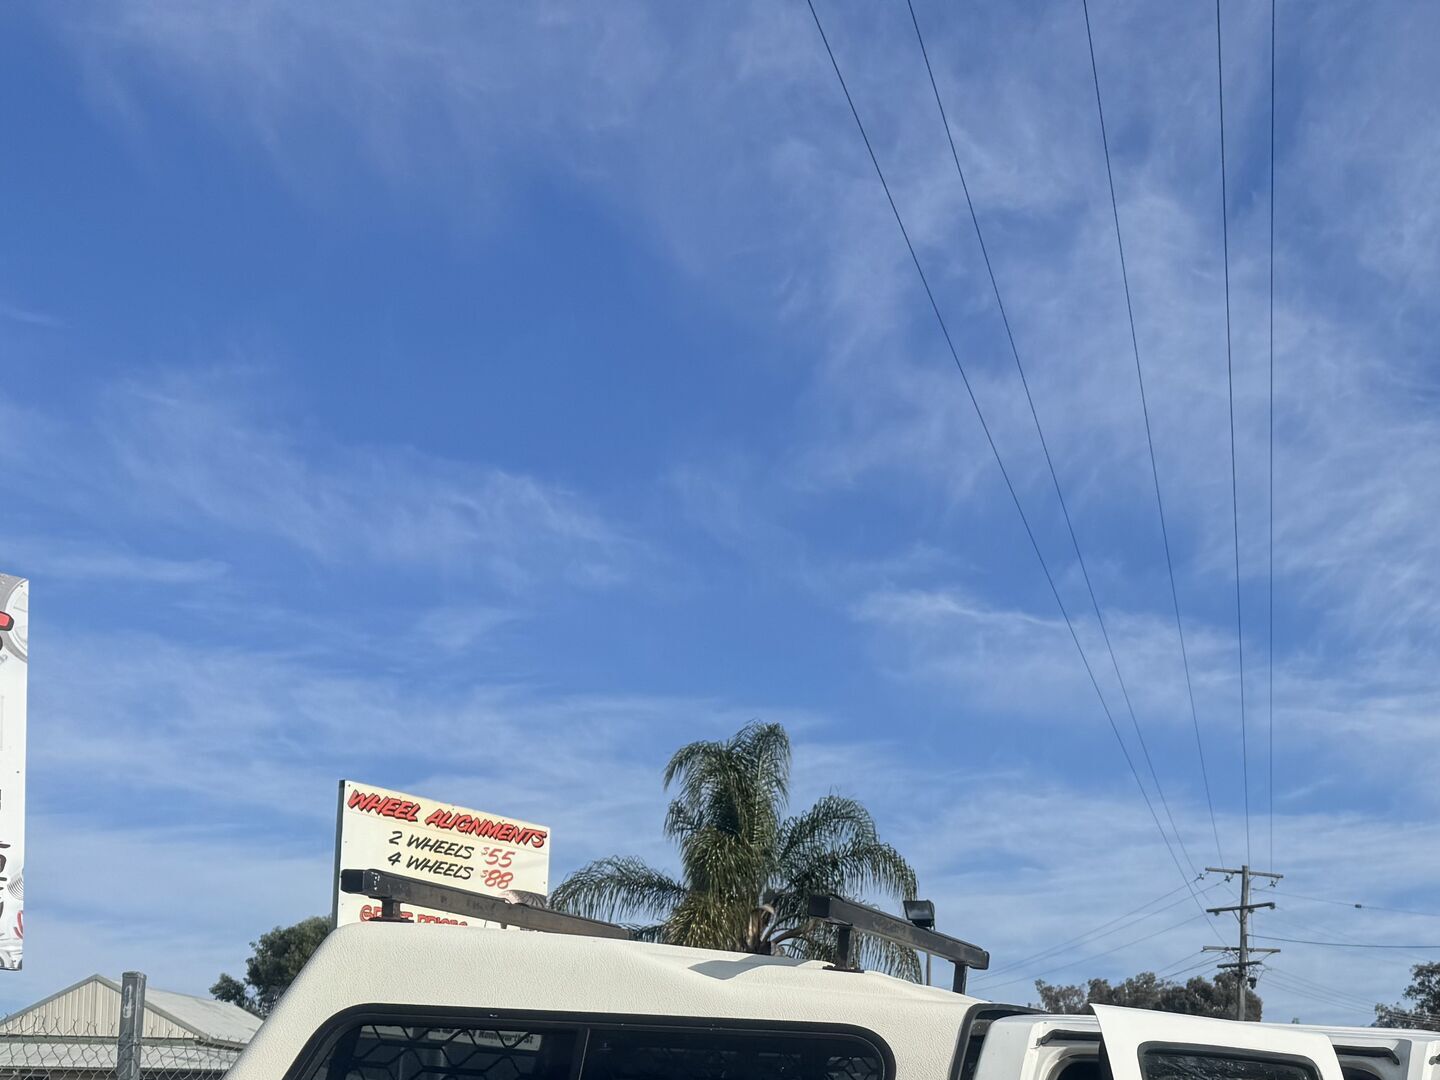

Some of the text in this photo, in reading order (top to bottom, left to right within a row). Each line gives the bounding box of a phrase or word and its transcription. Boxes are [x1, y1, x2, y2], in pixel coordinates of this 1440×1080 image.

[347, 790, 547, 848] WHEEL ALIGNMENTS
[388, 831, 516, 868] 2 WHEELS $55
[387, 851, 514, 890] 4 WHEELS $88
